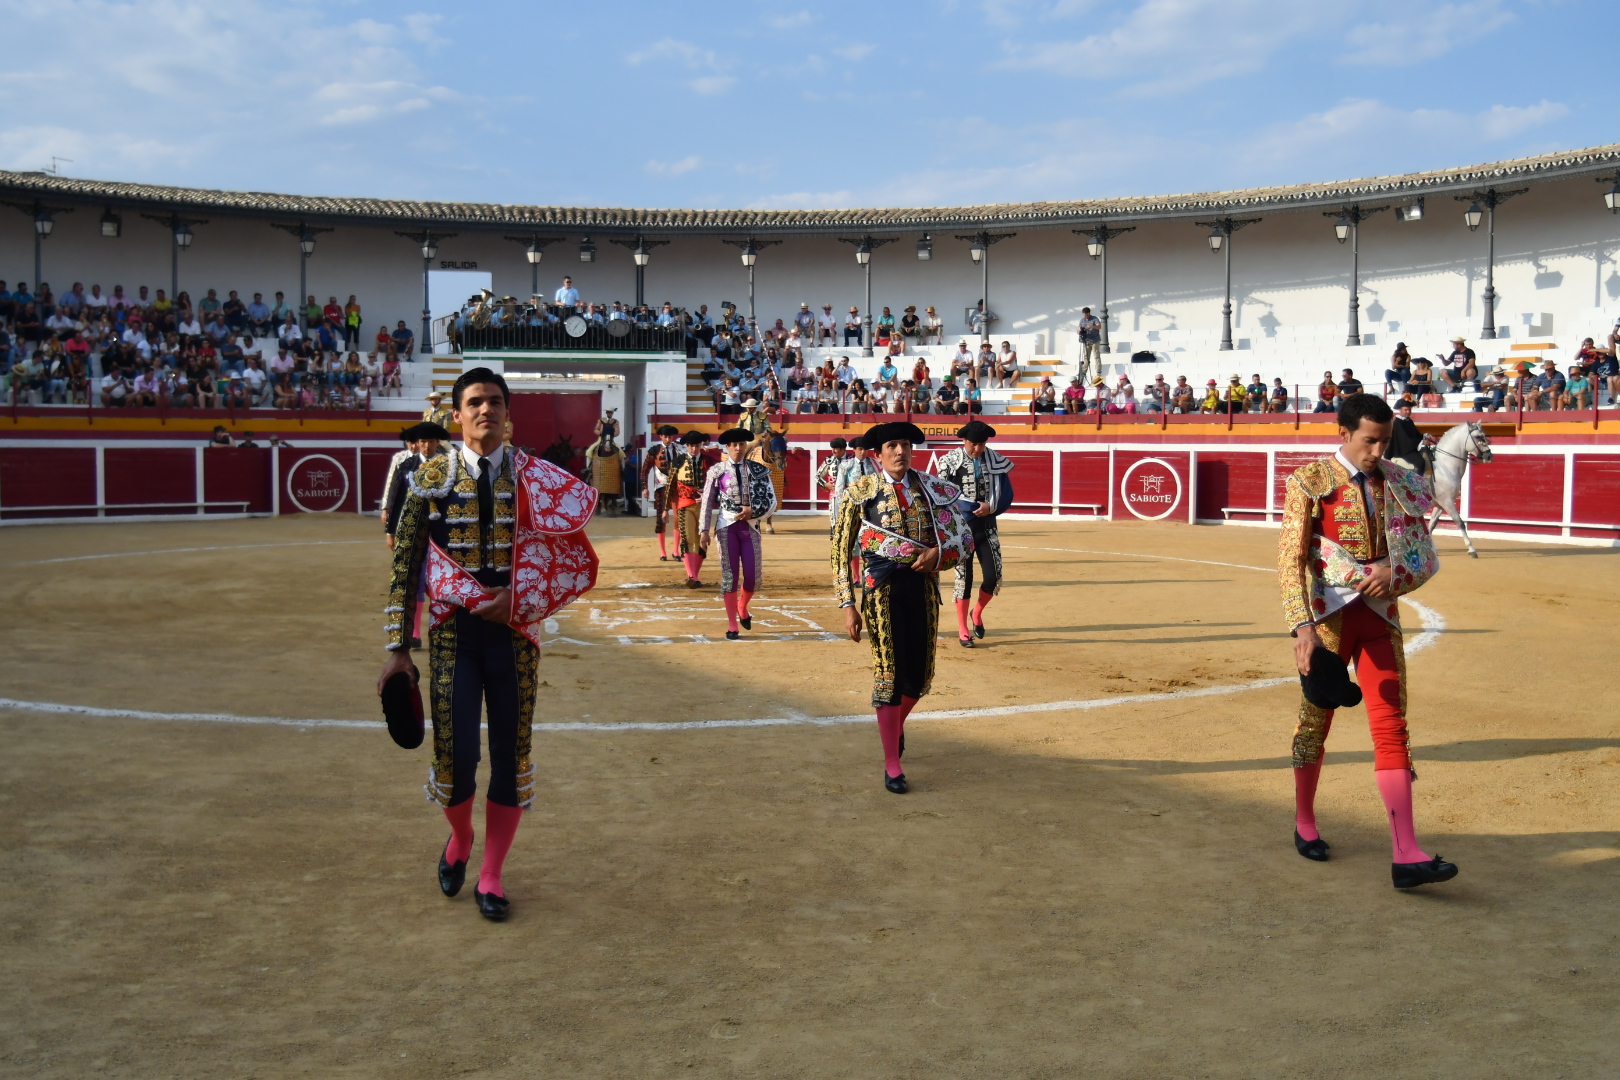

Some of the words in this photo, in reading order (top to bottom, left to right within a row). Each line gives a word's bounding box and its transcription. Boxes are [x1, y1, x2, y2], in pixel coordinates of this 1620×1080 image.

[441, 261, 478, 270] SALIDA
[922, 427, 959, 436] TORILE
[298, 489, 341, 498] SABIOTE
[1130, 493, 1172, 503] SABIOTE
